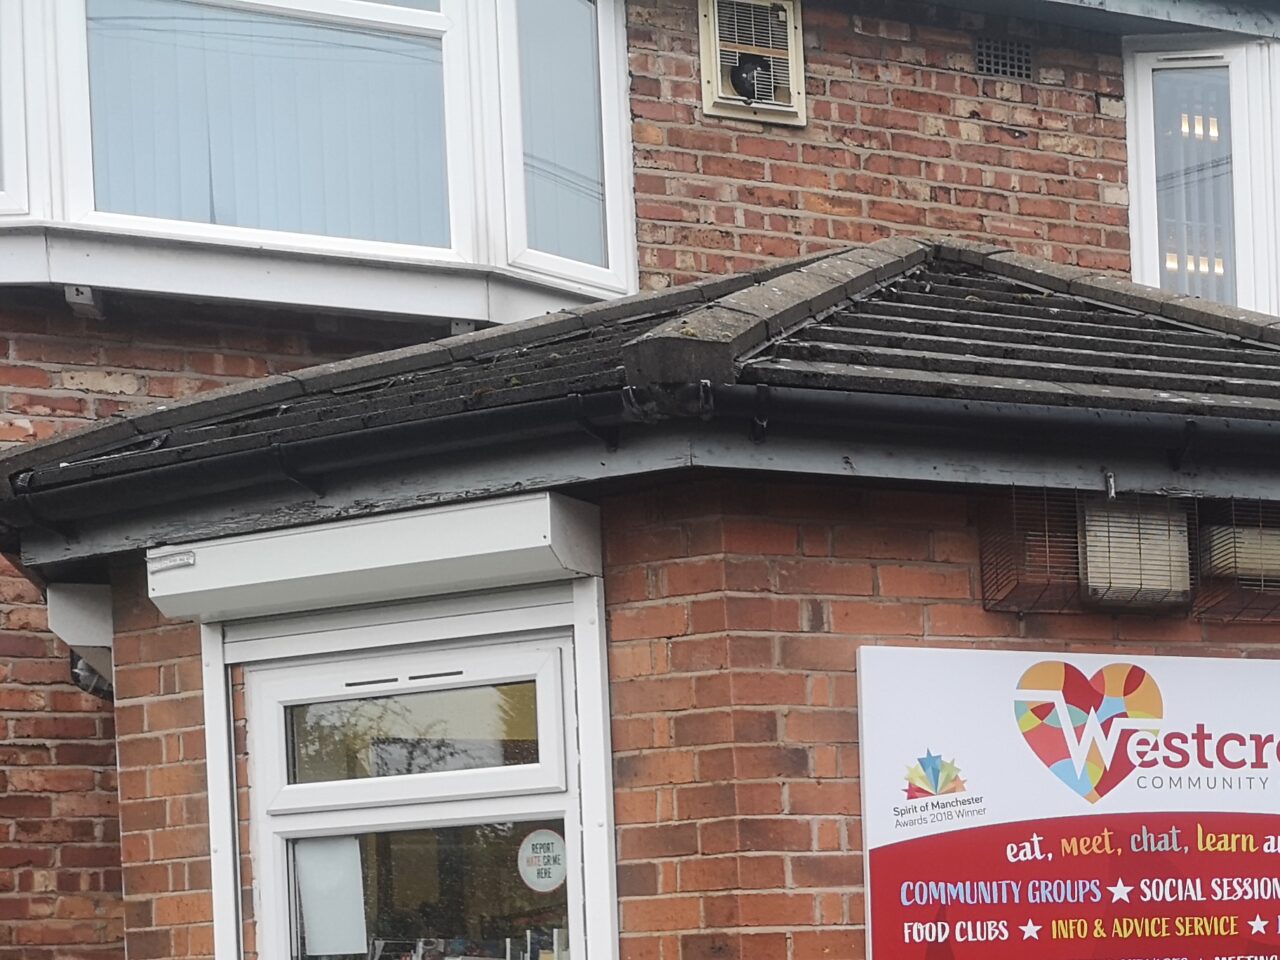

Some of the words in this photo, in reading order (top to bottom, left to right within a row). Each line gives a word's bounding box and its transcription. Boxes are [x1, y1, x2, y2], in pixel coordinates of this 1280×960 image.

[1136, 775, 1270, 791] COMMUNITY
[893, 805, 918, 818] Spirit
[919, 802, 930, 813] of
[931, 796, 984, 811] Manchester
[895, 815, 928, 829] Awards
[930, 811, 954, 823] 2018
[955, 807, 987, 819] Winner
[531, 842, 555, 854] REPORT
[1006, 832, 1053, 863] eat,
[1130, 825, 1189, 855] chat,
[1197, 823, 1259, 853] learn
[542, 854, 561, 867] CRIME
[536, 867, 552, 879] HERE
[900, 879, 1022, 906] COMMUNITY
[1027, 878, 1102, 904] GROUPS
[1139, 877, 1206, 902] SOCIAL
[903, 921, 950, 943] FOOD
[954, 920, 1009, 942] CLUBS
[1051, 918, 1088, 940] INFO
[1092, 919, 1107, 939] &
[1111, 916, 1171, 938] ADVICE
[1174, 915, 1240, 937] SERVICE
